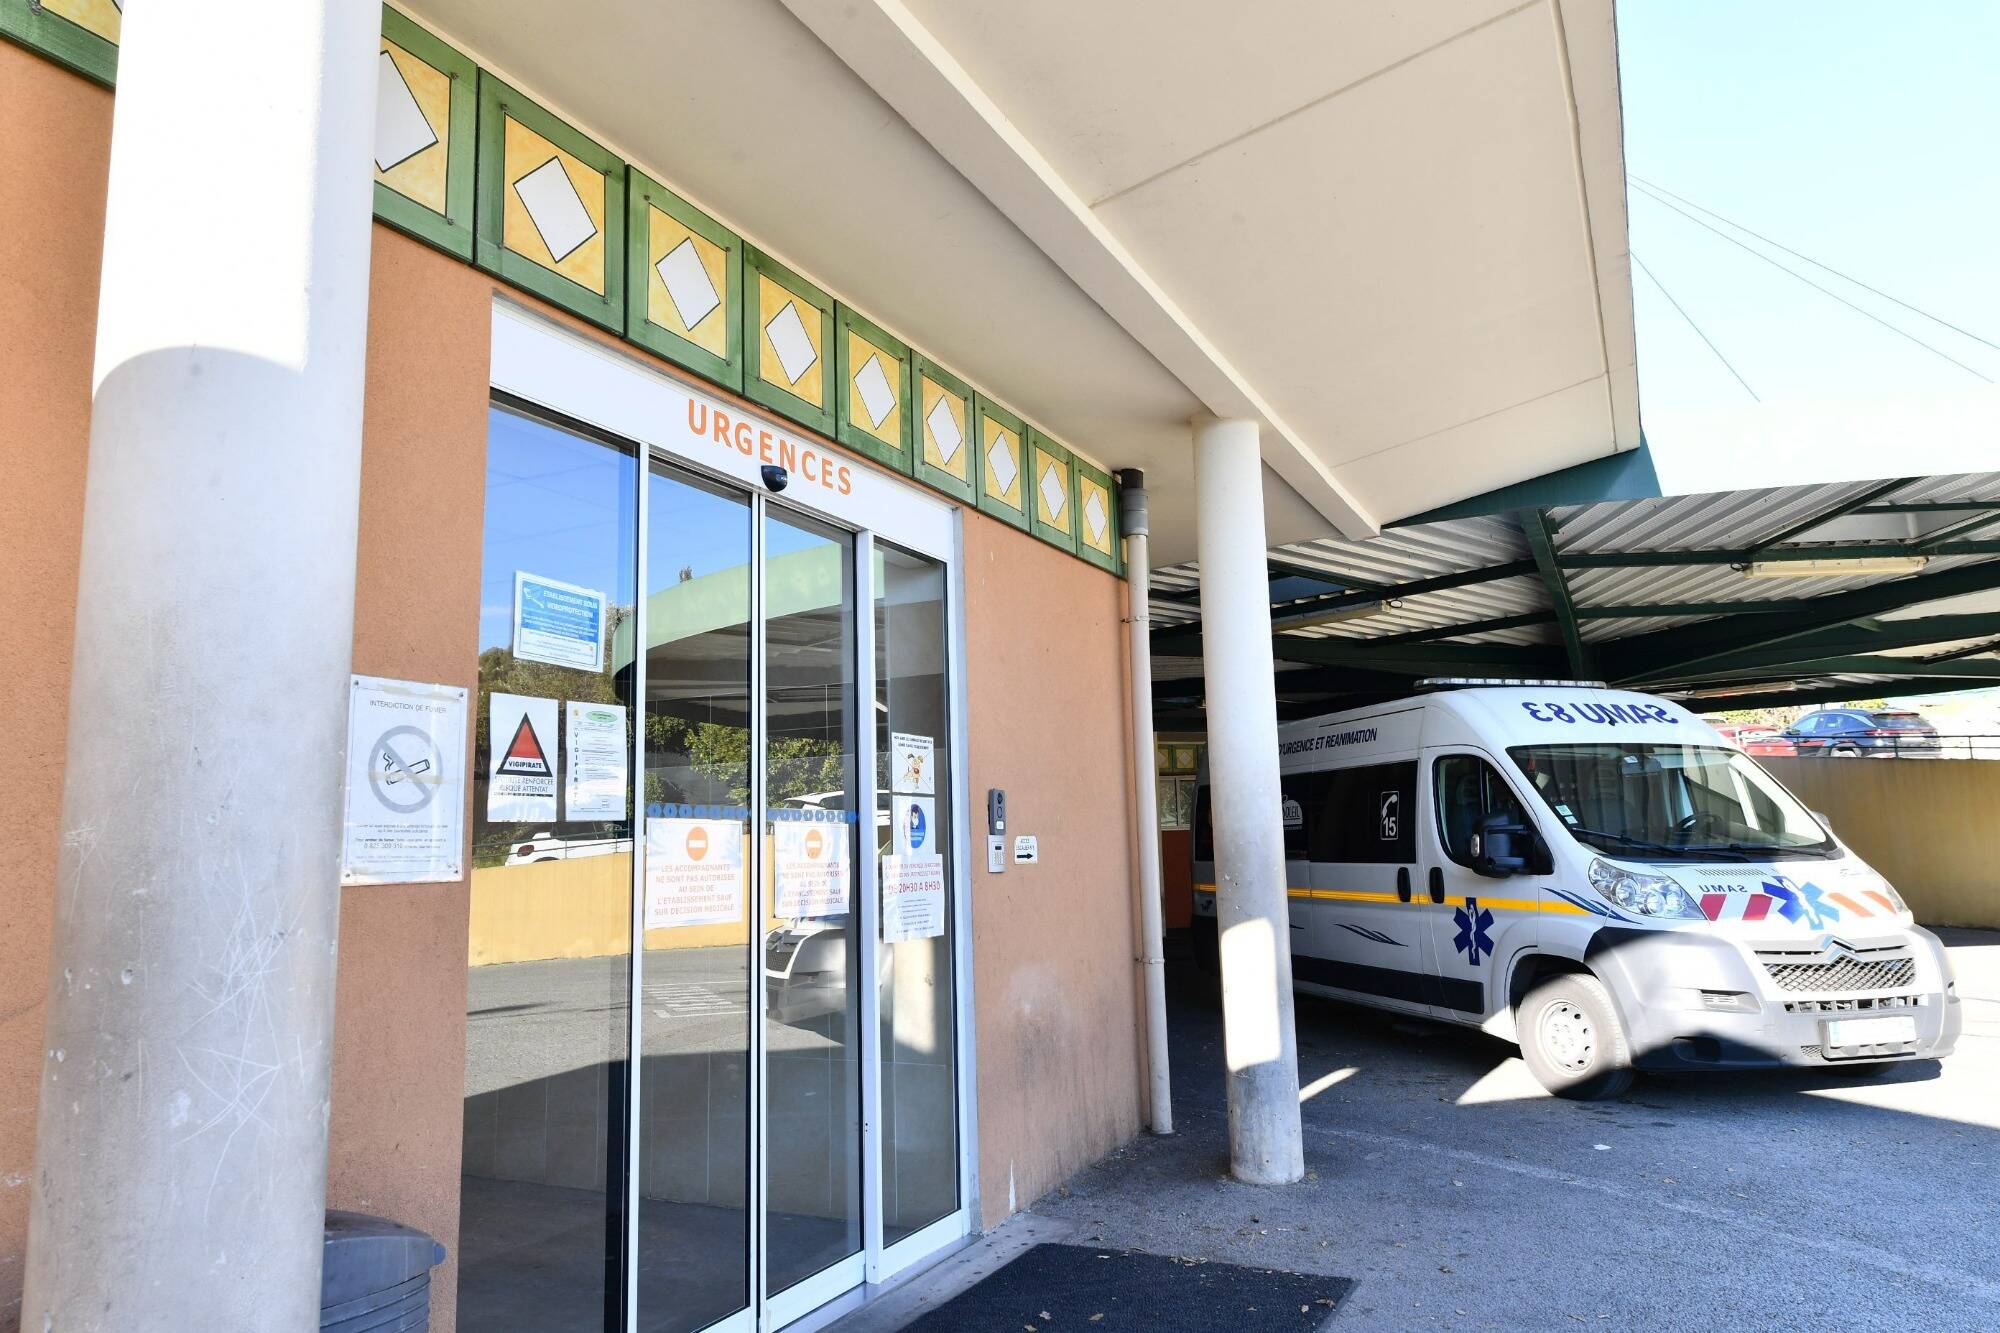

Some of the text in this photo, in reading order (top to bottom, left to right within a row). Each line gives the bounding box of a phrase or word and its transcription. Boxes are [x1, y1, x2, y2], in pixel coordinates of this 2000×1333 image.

[688, 399, 852, 496] URGENCES
[370, 700, 414, 710] INTERDICTION
[425, 706, 447, 714] FUMER
[1314, 737, 1326, 750] ET
[1325, 728, 1378, 748] REANIMATION
[508, 760, 542, 768] VIGIPIRATE
[1384, 816, 1396, 836] 15
[898, 882, 918, 894] 20H30
[919, 882, 924, 892] A
[924, 880, 940, 892] 8H30
